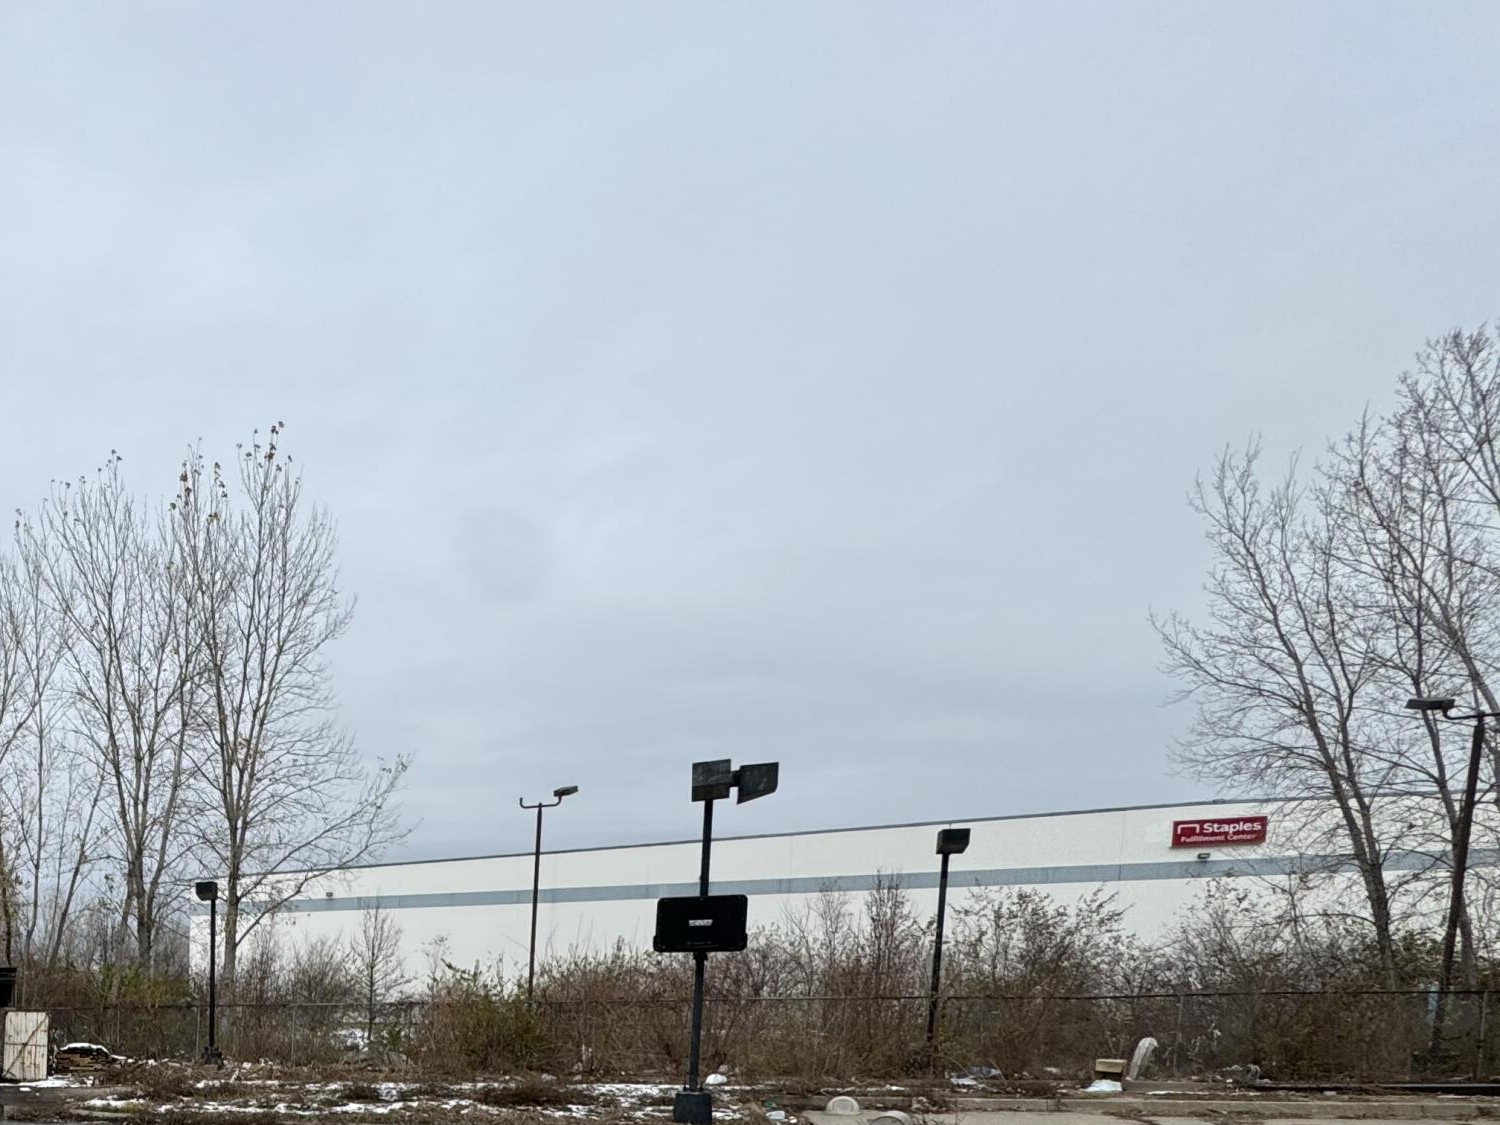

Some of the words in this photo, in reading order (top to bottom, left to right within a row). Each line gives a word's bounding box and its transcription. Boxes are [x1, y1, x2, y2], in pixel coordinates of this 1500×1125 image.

[1202, 821, 1262, 834] Staples
[1180, 834, 1225, 843] Fulfillment
[1227, 833, 1257, 841] Center
